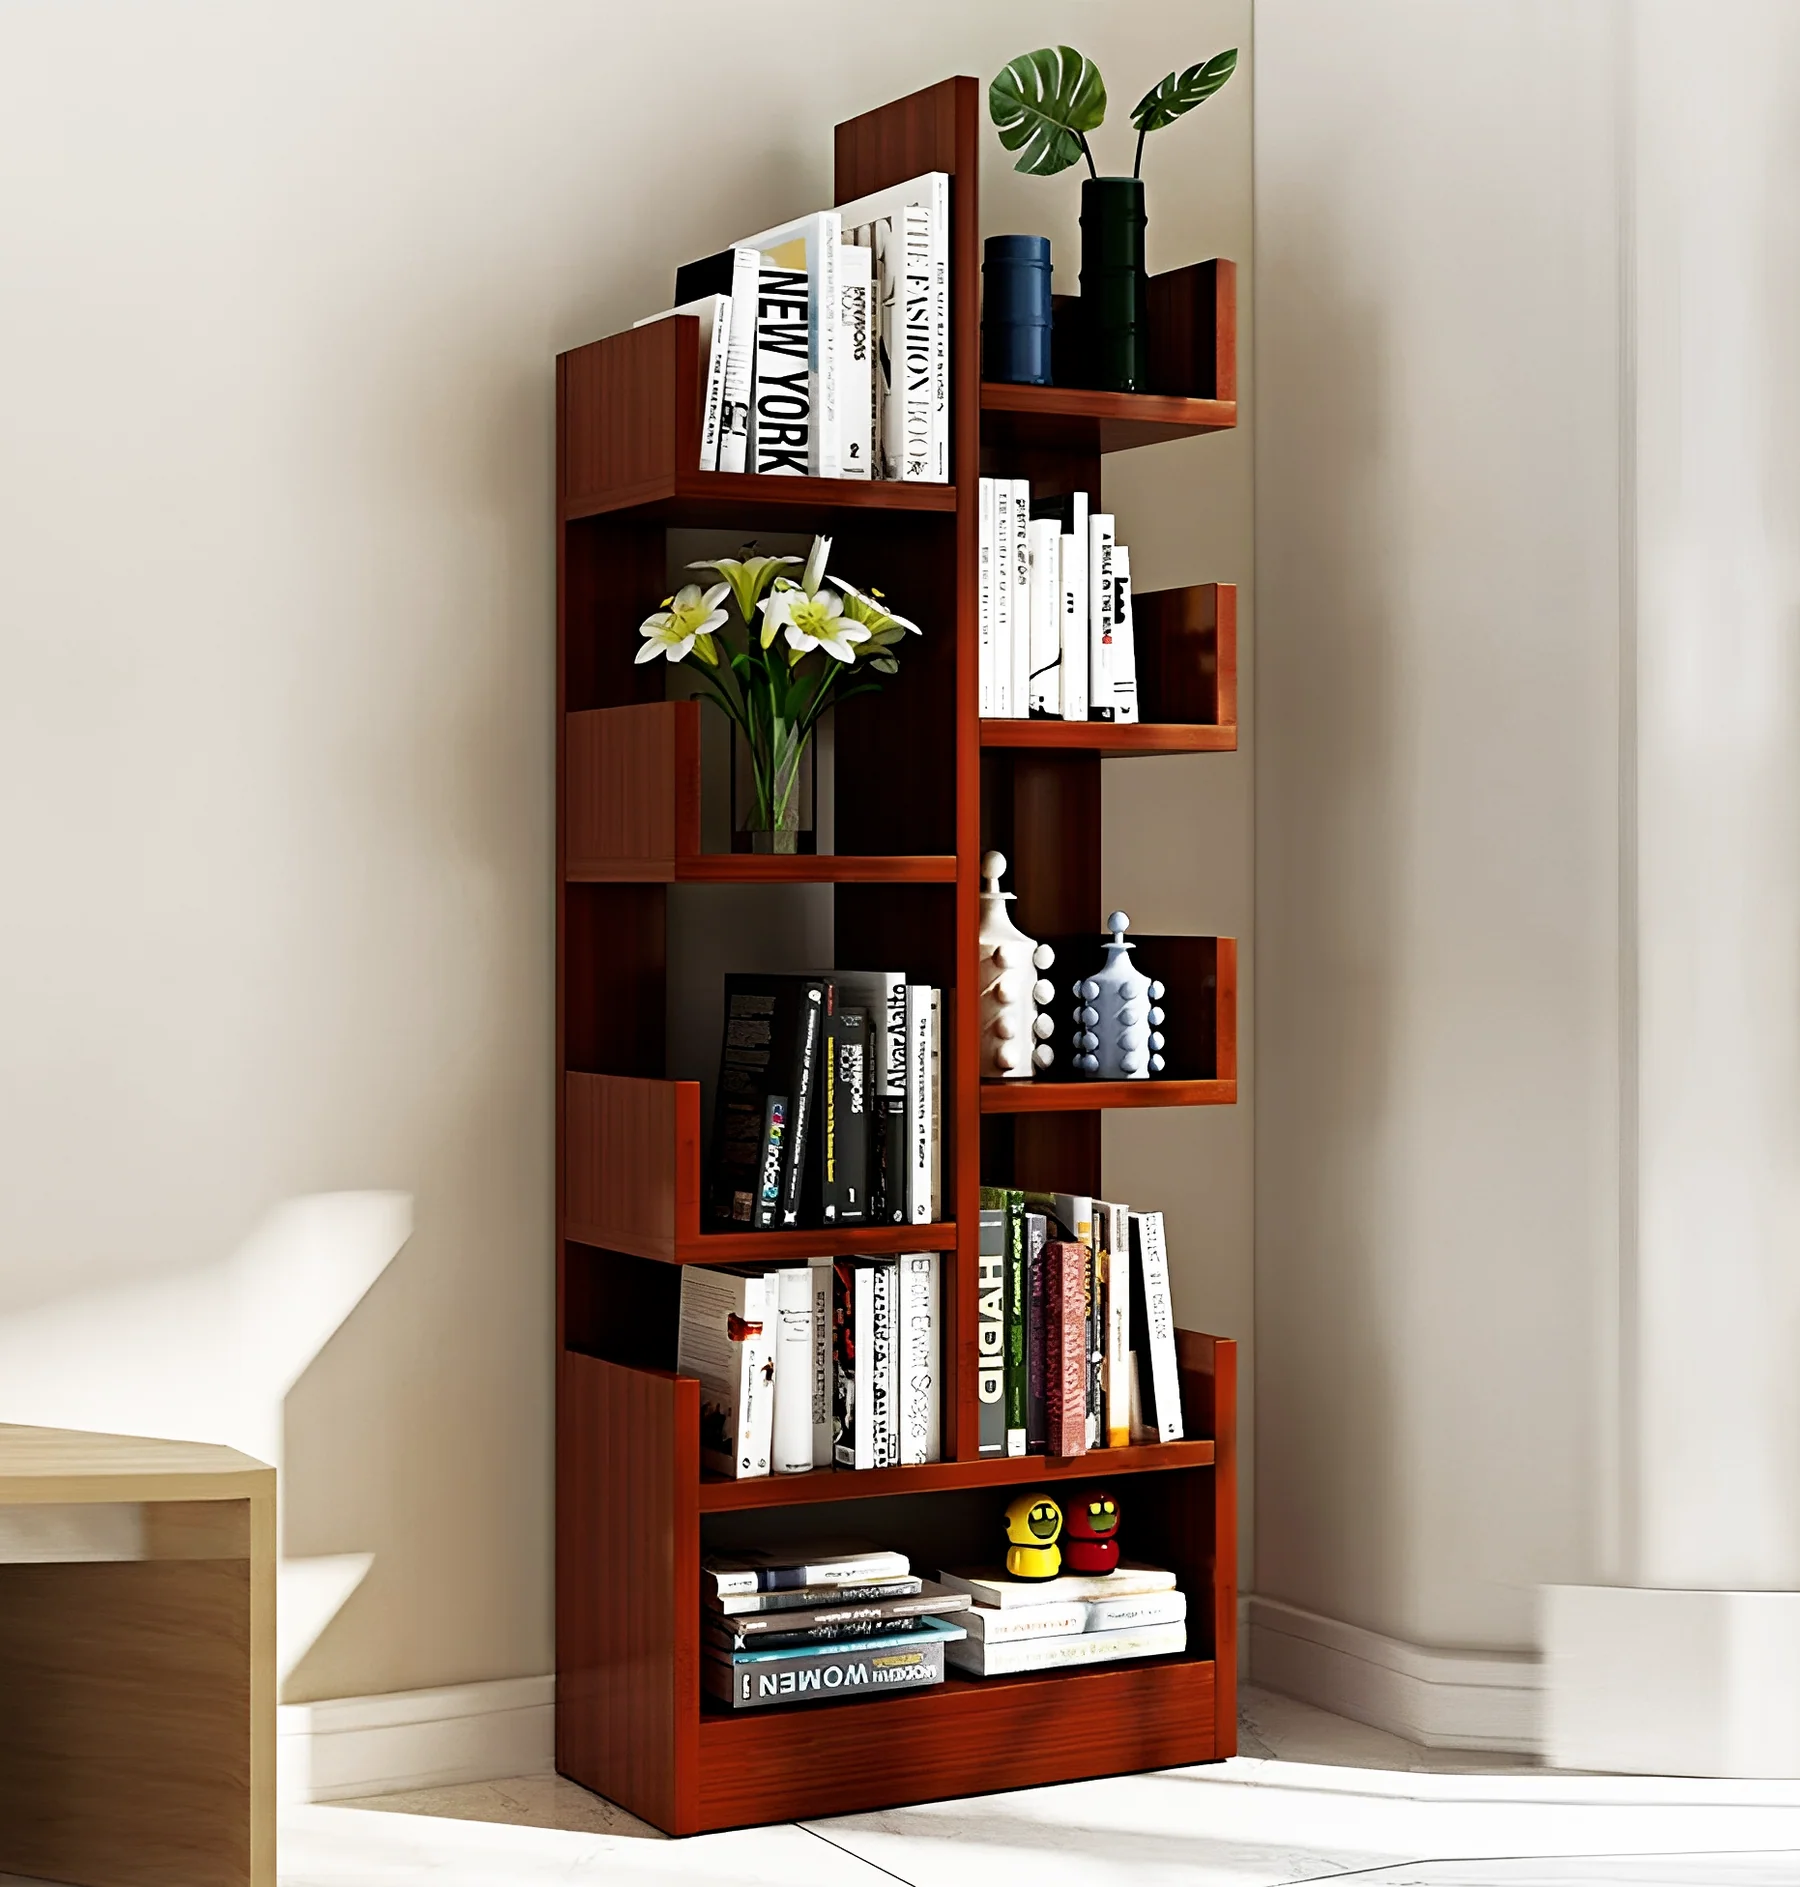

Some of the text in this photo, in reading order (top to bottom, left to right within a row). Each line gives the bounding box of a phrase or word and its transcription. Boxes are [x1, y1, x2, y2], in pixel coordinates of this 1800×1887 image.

[757, 269, 809, 475] NEW YORK
[906, 275, 930, 391] FASHION
[849, 442, 860, 459] 2
[887, 984, 906, 1088] Alvar Aalto
[759, 1663, 869, 1697] WOMEN
